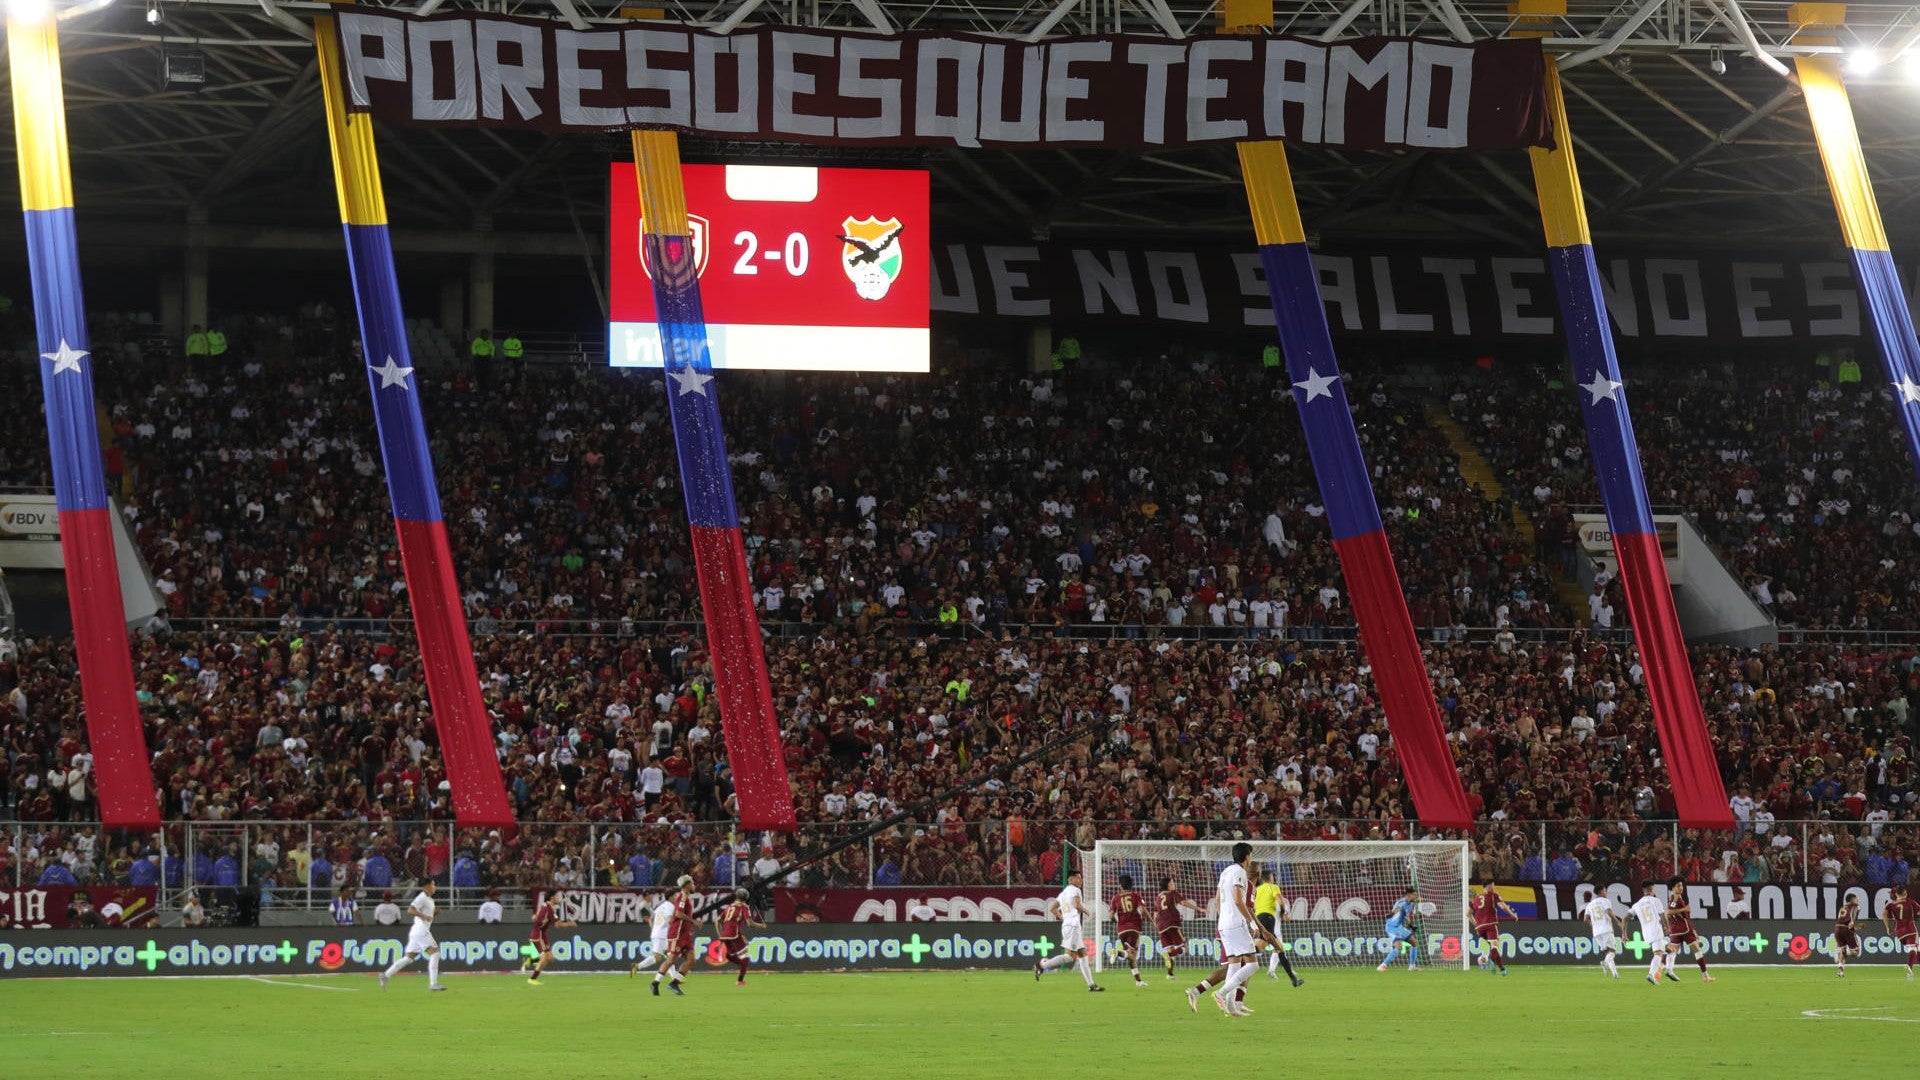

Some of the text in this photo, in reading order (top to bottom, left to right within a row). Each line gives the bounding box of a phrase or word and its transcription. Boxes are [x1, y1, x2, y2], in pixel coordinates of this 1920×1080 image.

[1264, 41, 1476, 148] AMO
[1071, 248, 1210, 323] NO
[1731, 261, 1862, 338] ES
[16, 513, 46, 525] BDV
[1595, 531, 1612, 542] BD
[1120, 896, 1134, 913] 16
[1160, 896, 1168, 910] 2
